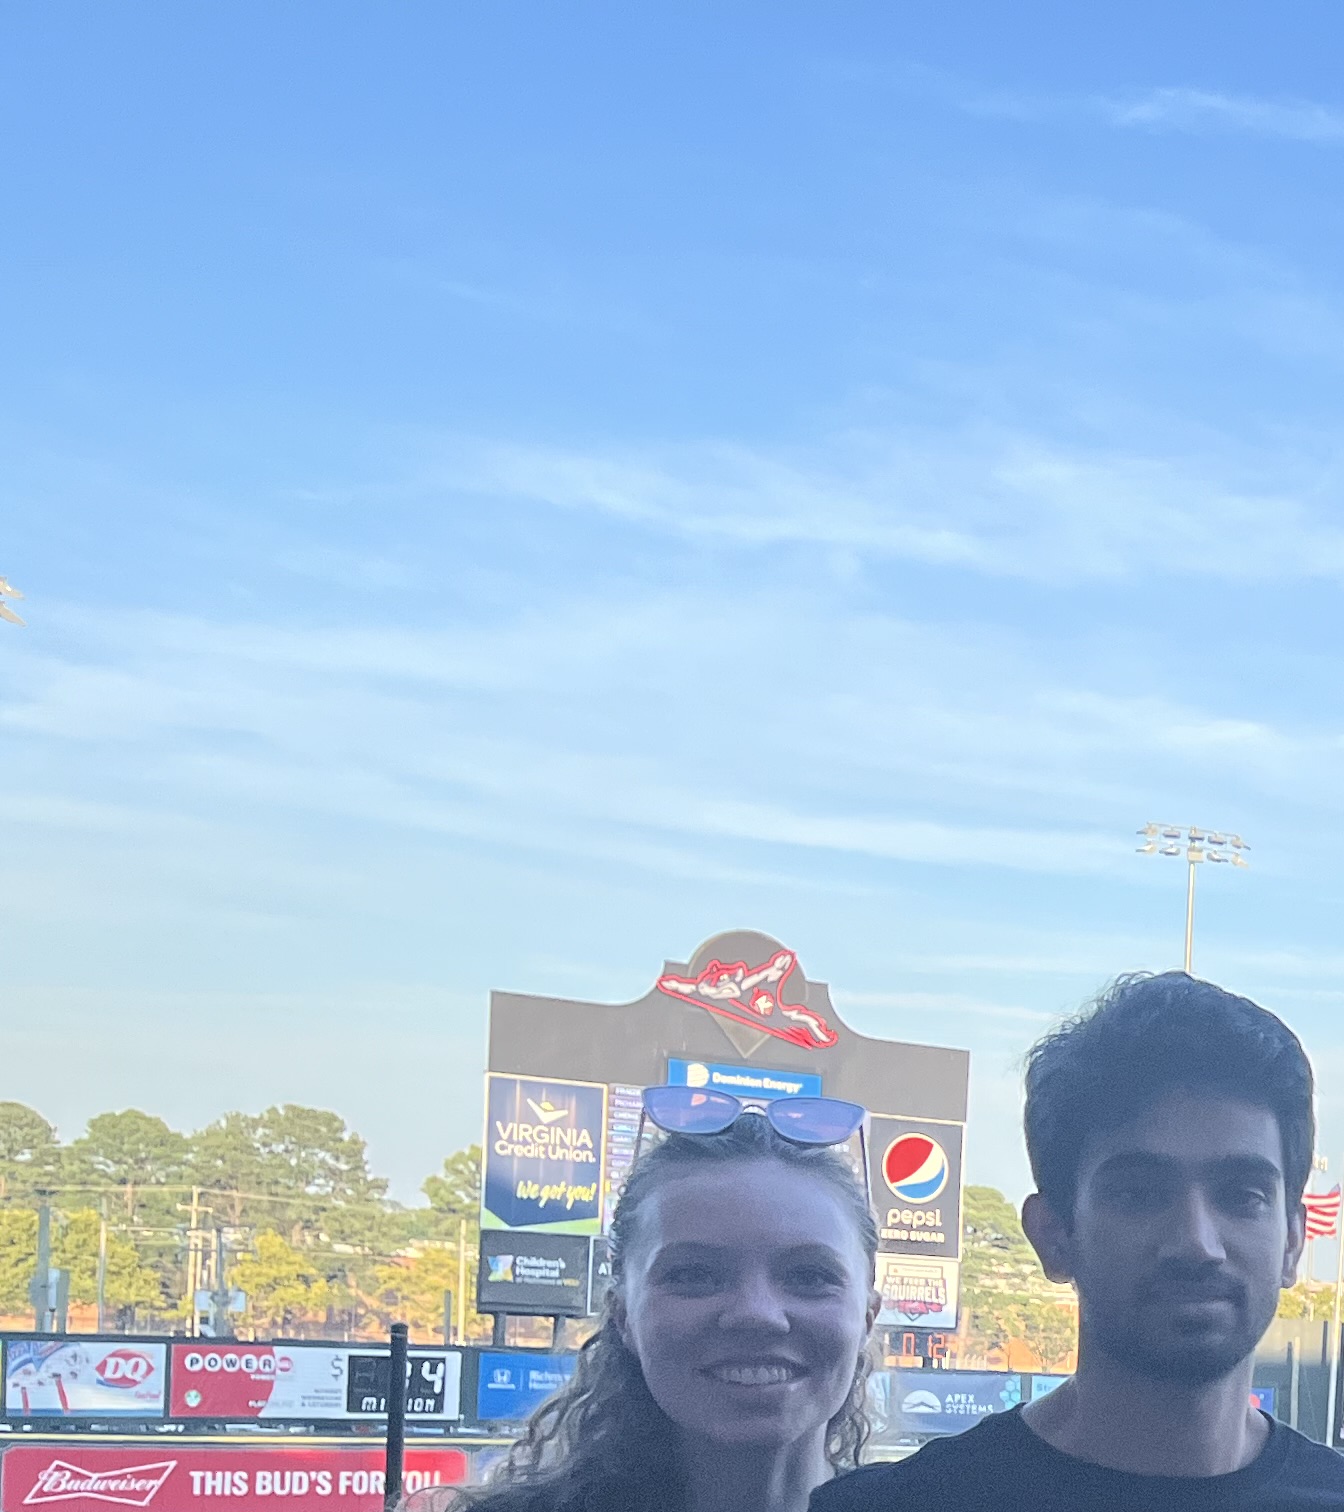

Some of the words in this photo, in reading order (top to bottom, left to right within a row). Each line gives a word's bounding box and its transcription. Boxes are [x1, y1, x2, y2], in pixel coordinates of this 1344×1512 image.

[495, 1121, 594, 1149] VIRGINIA
[494, 1140, 545, 1160] Credit
[516, 1180, 539, 1200] We
[538, 1181, 567, 1209] got
[566, 1182, 598, 1211] you!
[887, 1208, 943, 1229] pepsi
[881, 1229, 910, 1242] ZERO
[911, 1230, 945, 1244] SUGAR
[515, 1266, 560, 1279] Hospital
[882, 1285, 947, 1305] SQUIRRELS
[103, 1356, 149, 1384] DQ
[362, 1396, 435, 1412] MIION
[945, 1393, 975, 1404] APEX
[945, 1404, 994, 1415] SYSTEMS
[38, 1470, 159, 1494] Budweiser
[189, 1470, 249, 1496] THIS
[255, 1471, 333, 1496] BUD'S
[339, 1471, 386, 1495] FOR
